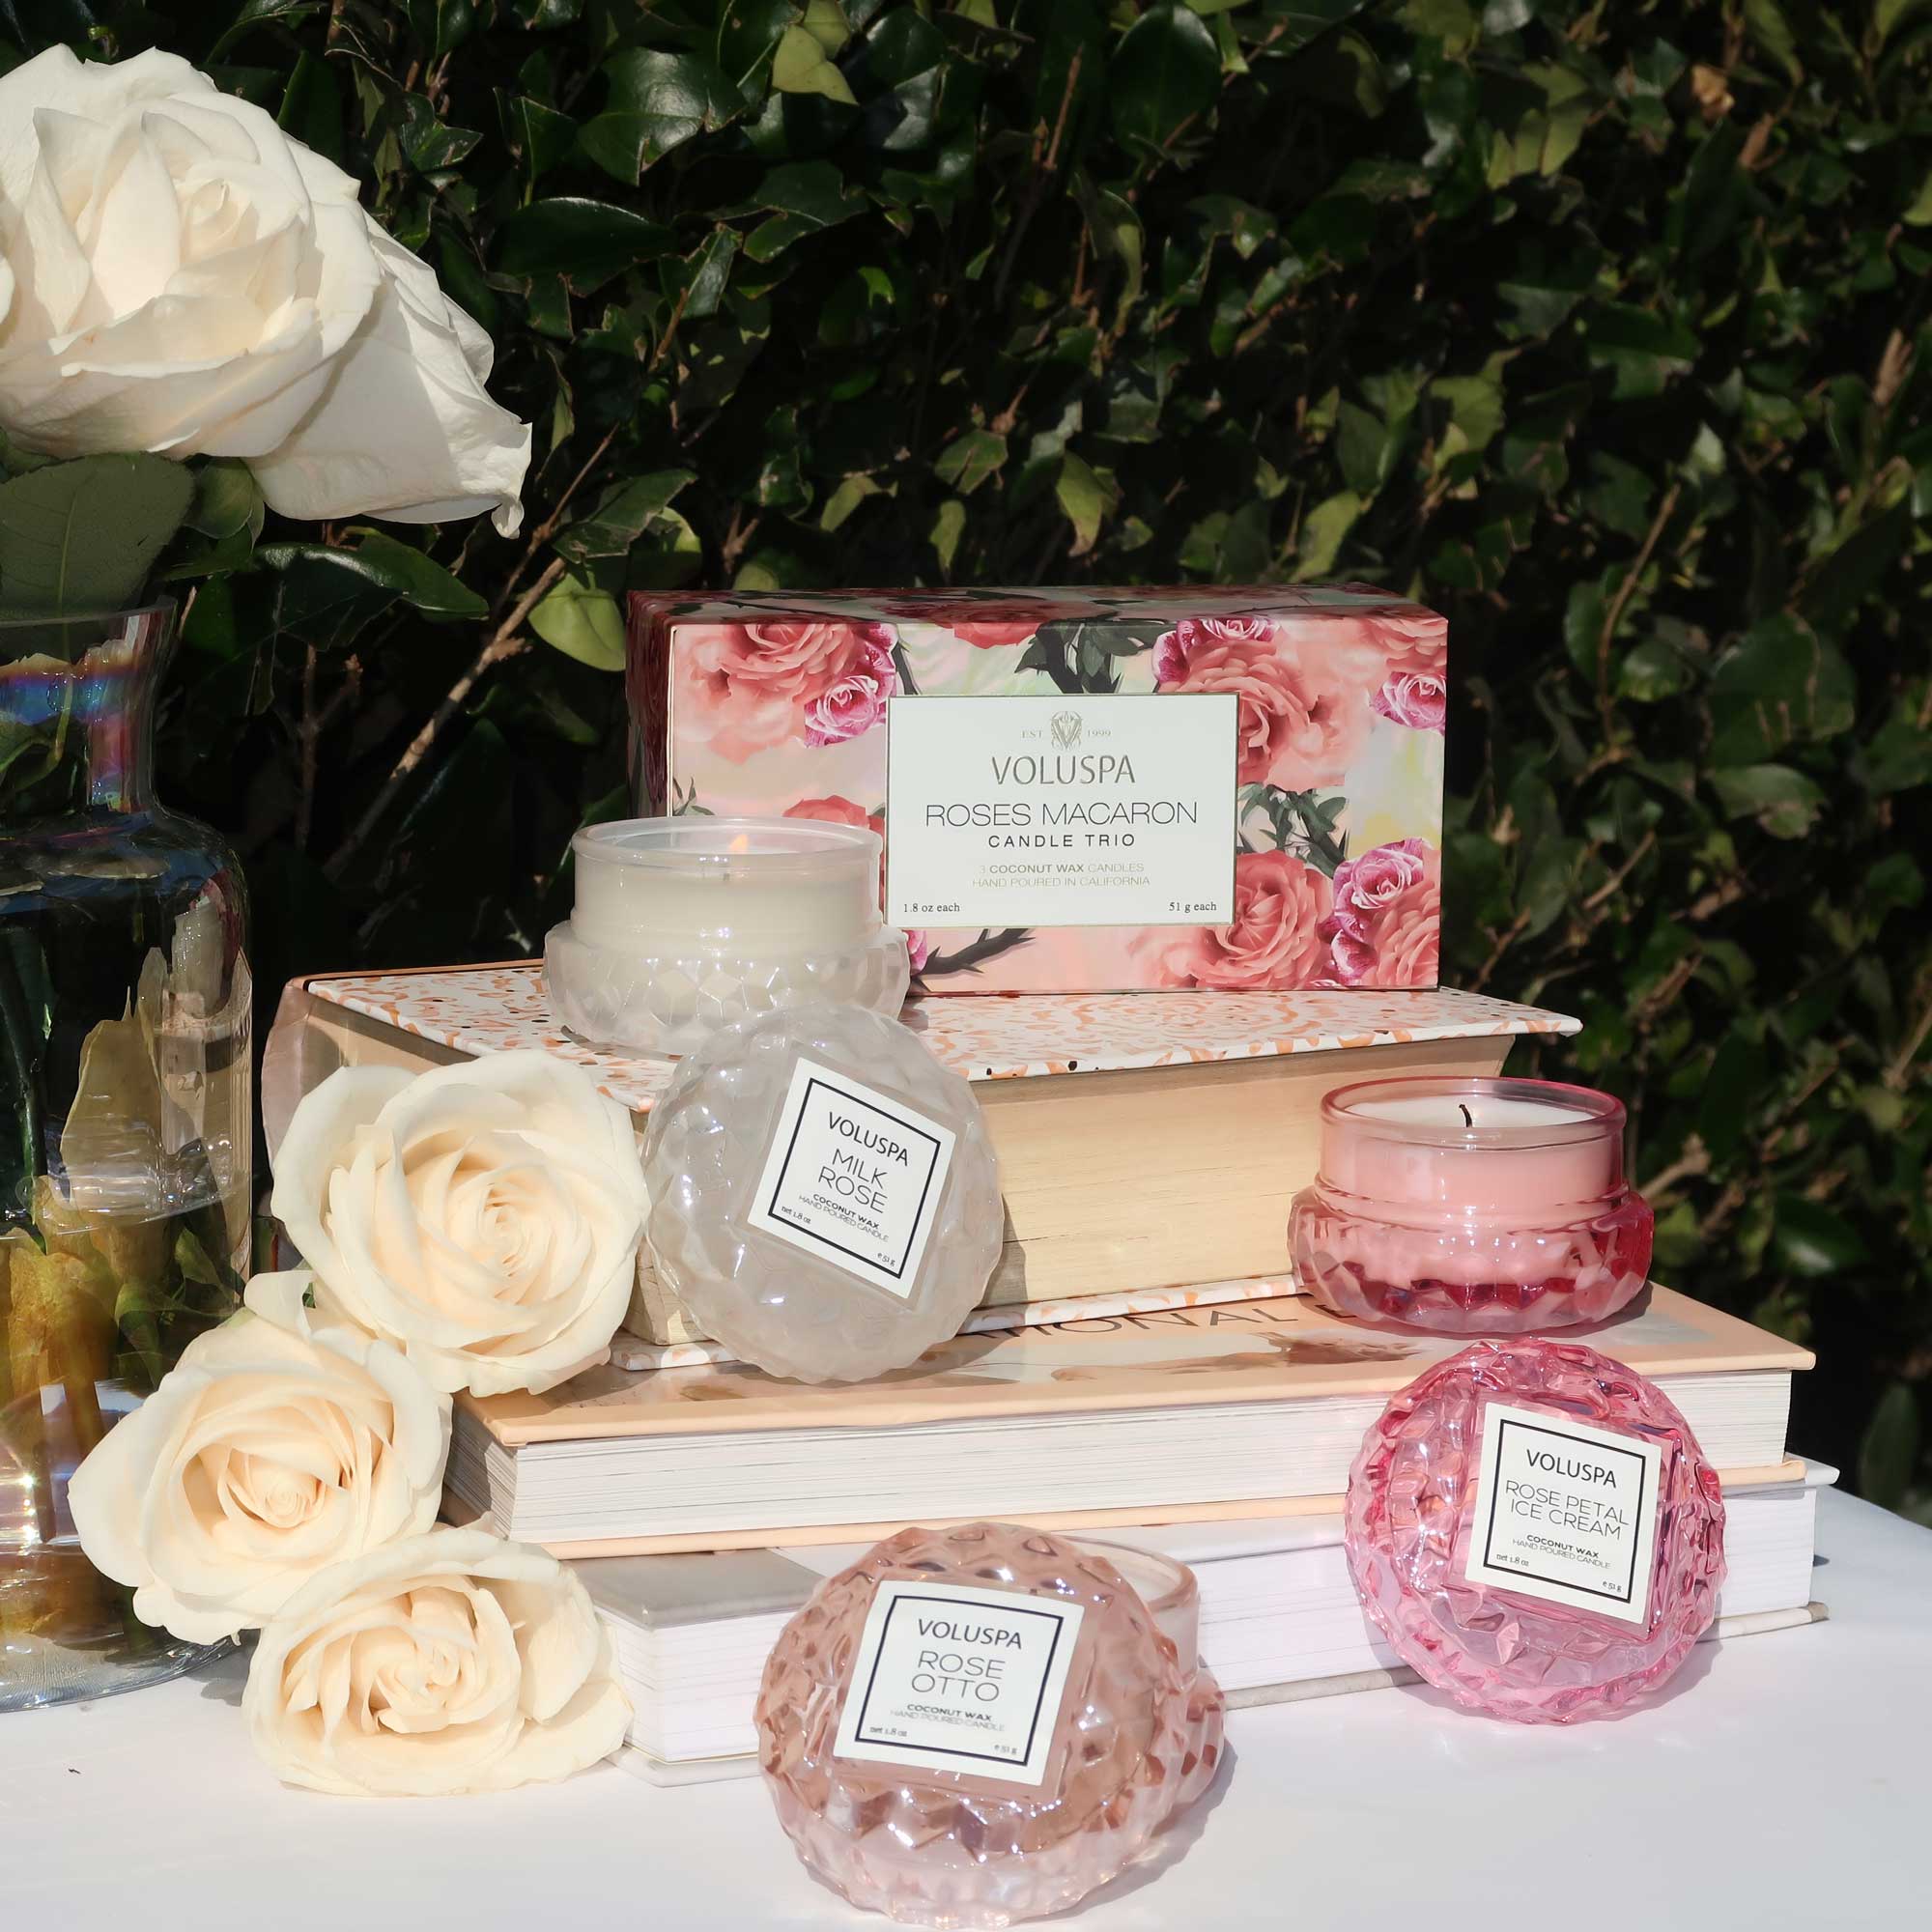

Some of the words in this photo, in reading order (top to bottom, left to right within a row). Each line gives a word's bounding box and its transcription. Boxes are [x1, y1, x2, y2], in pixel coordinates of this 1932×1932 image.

[1022, 729, 1042, 739] EST
[1087, 729, 1111, 738] 1999
[991, 754, 1136, 785] VOLUSPA
[925, 804, 1031, 827] ROSES
[1042, 801, 1197, 826] MACARON
[988, 835, 1073, 848] CANDLE
[1085, 834, 1135, 847] TRIO
[972, 878, 1007, 888] HAND
[1010, 877, 1061, 888] POURED
[1065, 877, 1076, 887] IN
[1079, 876, 1151, 887] CALIFORNIA
[989, 864, 1052, 874] COCONUT
[1056, 864, 1085, 873] WAX
[1088, 863, 1144, 873] CANDLES
[903, 903, 919, 913] 1.8
[936, 902, 960, 913] each
[1169, 902, 1180, 912] 51
[1184, 904, 1190, 914] g
[1193, 901, 1217, 912] each
[829, 1111, 908, 1166] VOLUSPA
[832, 1149, 887, 1189] MILK
[818, 1166, 888, 1213] ROSE
[781, 1206, 791, 1215] net
[793, 1210, 803, 1219] 1.8
[799, 1195, 822, 1210] HAND
[823, 1207, 856, 1227] POURED
[857, 1222, 889, 1242] CANDLE
[813, 1194, 856, 1218] COCONUT
[858, 1214, 879, 1229] WAX
[1526, 1449, 1617, 1489] VOLUSPA
[1506, 1480, 1561, 1507] ROSE
[1566, 1495, 1630, 1525] PETAL
[1511, 1498, 1544, 1520] ICE
[1548, 1509, 1621, 1540] CREAM
[1513, 1539, 1538, 1549] HAND
[1540, 1545, 1576, 1559] POURED
[1577, 1554, 1611, 1569] CANDLE
[1526, 1534, 1574, 1551] COCONUT
[1576, 1547, 1600, 1558] WAX
[918, 1618, 1022, 1650] VOLUSPA
[918, 1650, 1006, 1680] ROSE
[911, 1673, 999, 1701] OTTO
[890, 1710, 920, 1719] HAND
[921, 1713, 963, 1725] POURED
[964, 1719, 1006, 1731] CANDLE
[907, 1703, 962, 1717] COCONUT
[964, 1712, 992, 1721] WAX
